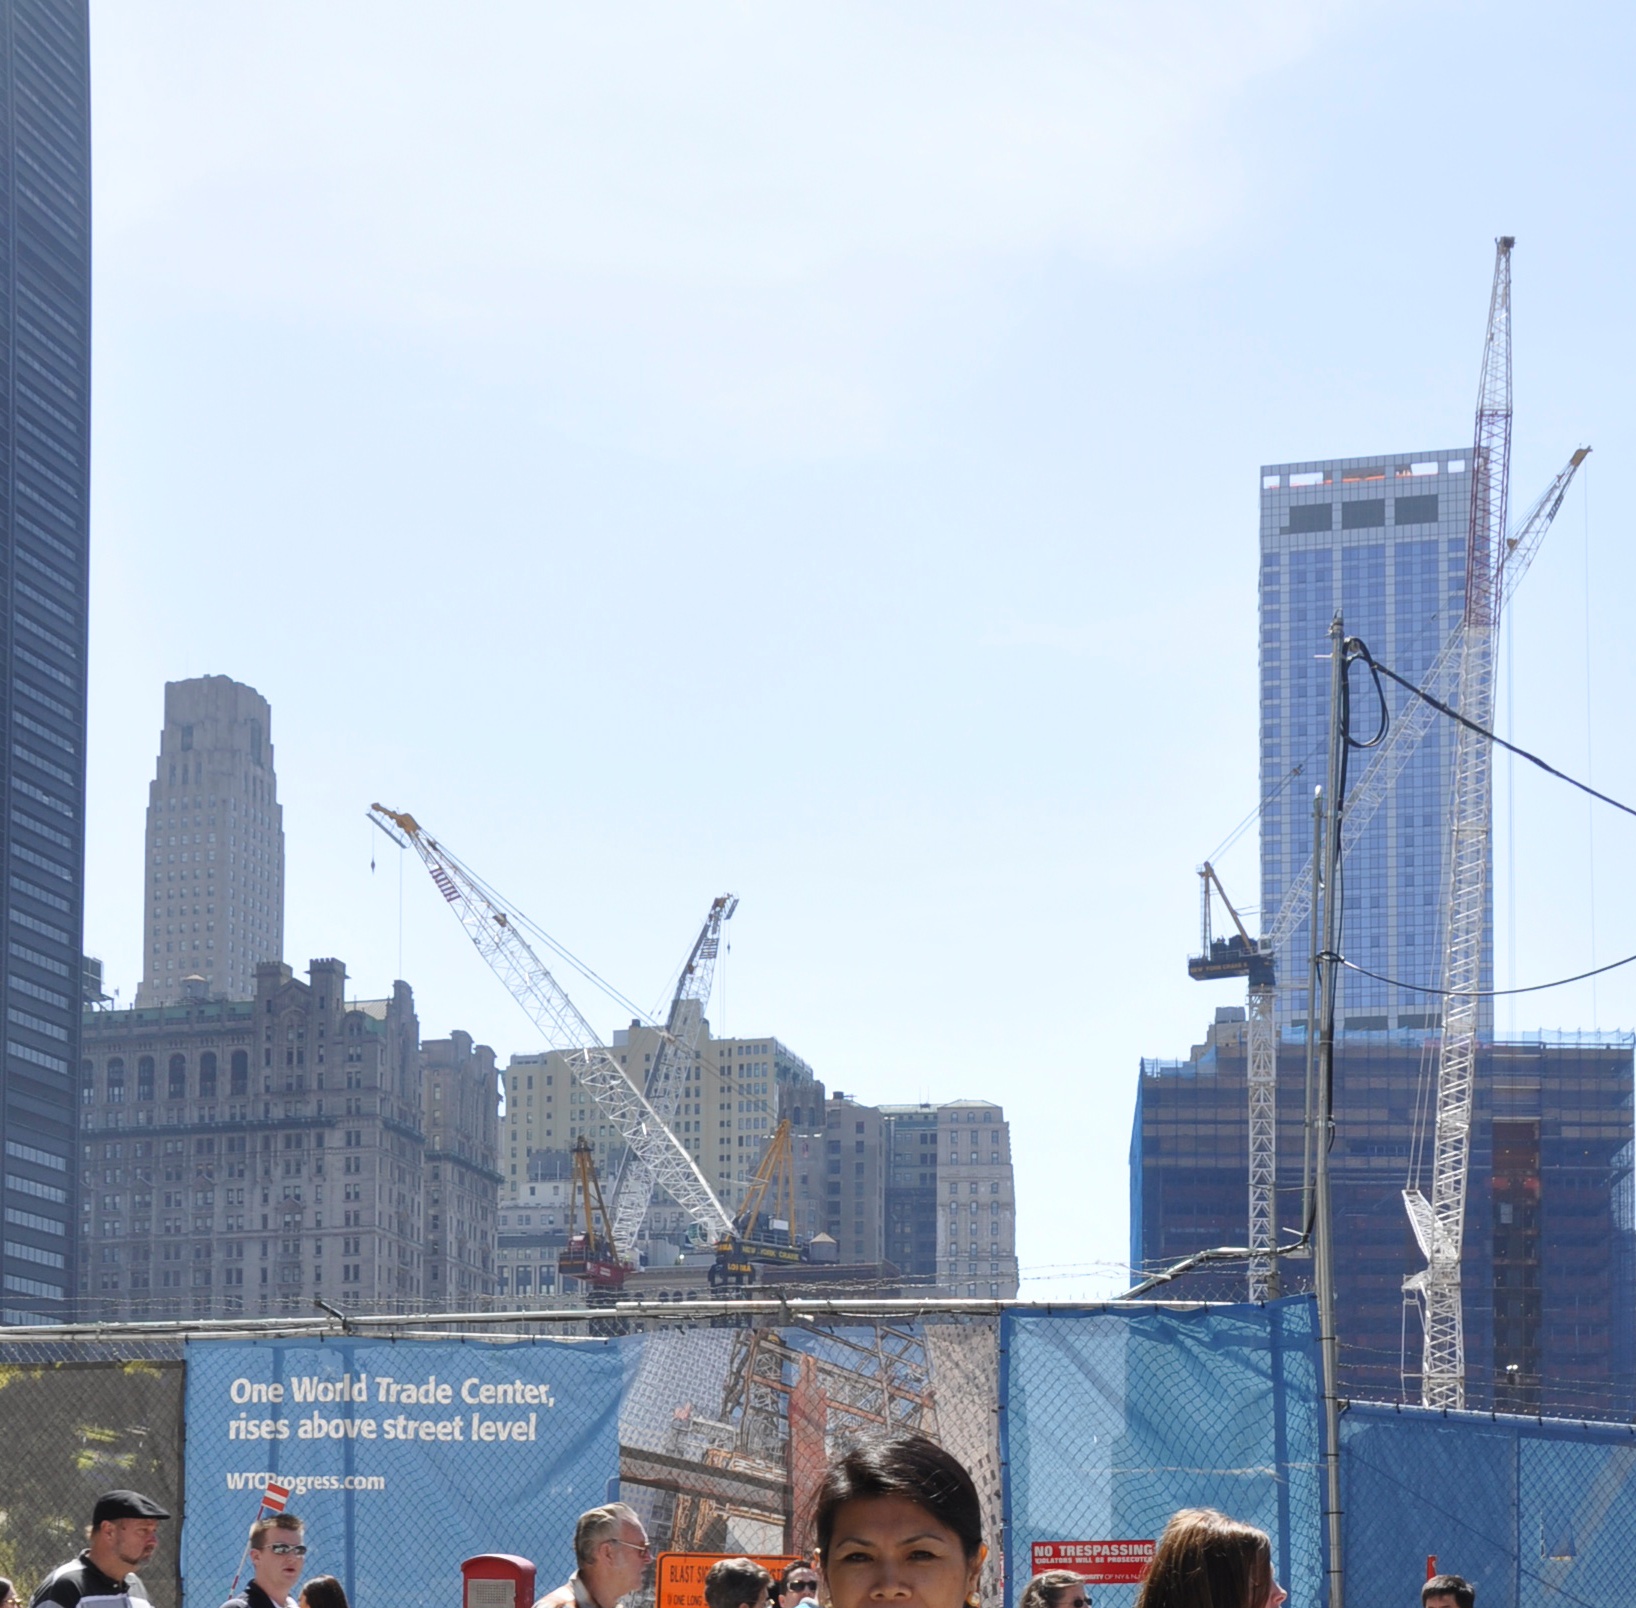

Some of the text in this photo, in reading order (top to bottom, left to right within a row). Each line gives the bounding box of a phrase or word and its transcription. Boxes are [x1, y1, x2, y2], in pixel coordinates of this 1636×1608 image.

[230, 1373, 555, 1408] One World Trade Center,
[229, 1409, 537, 1442] rises above street level
[226, 1471, 385, 1495] WTCProgress.com
[1034, 1545, 1153, 1557] NO TRESPASSING
[670, 1565, 694, 1583] BLAST
[673, 1594, 685, 1605] ONE
[687, 1595, 703, 1606] LONG
